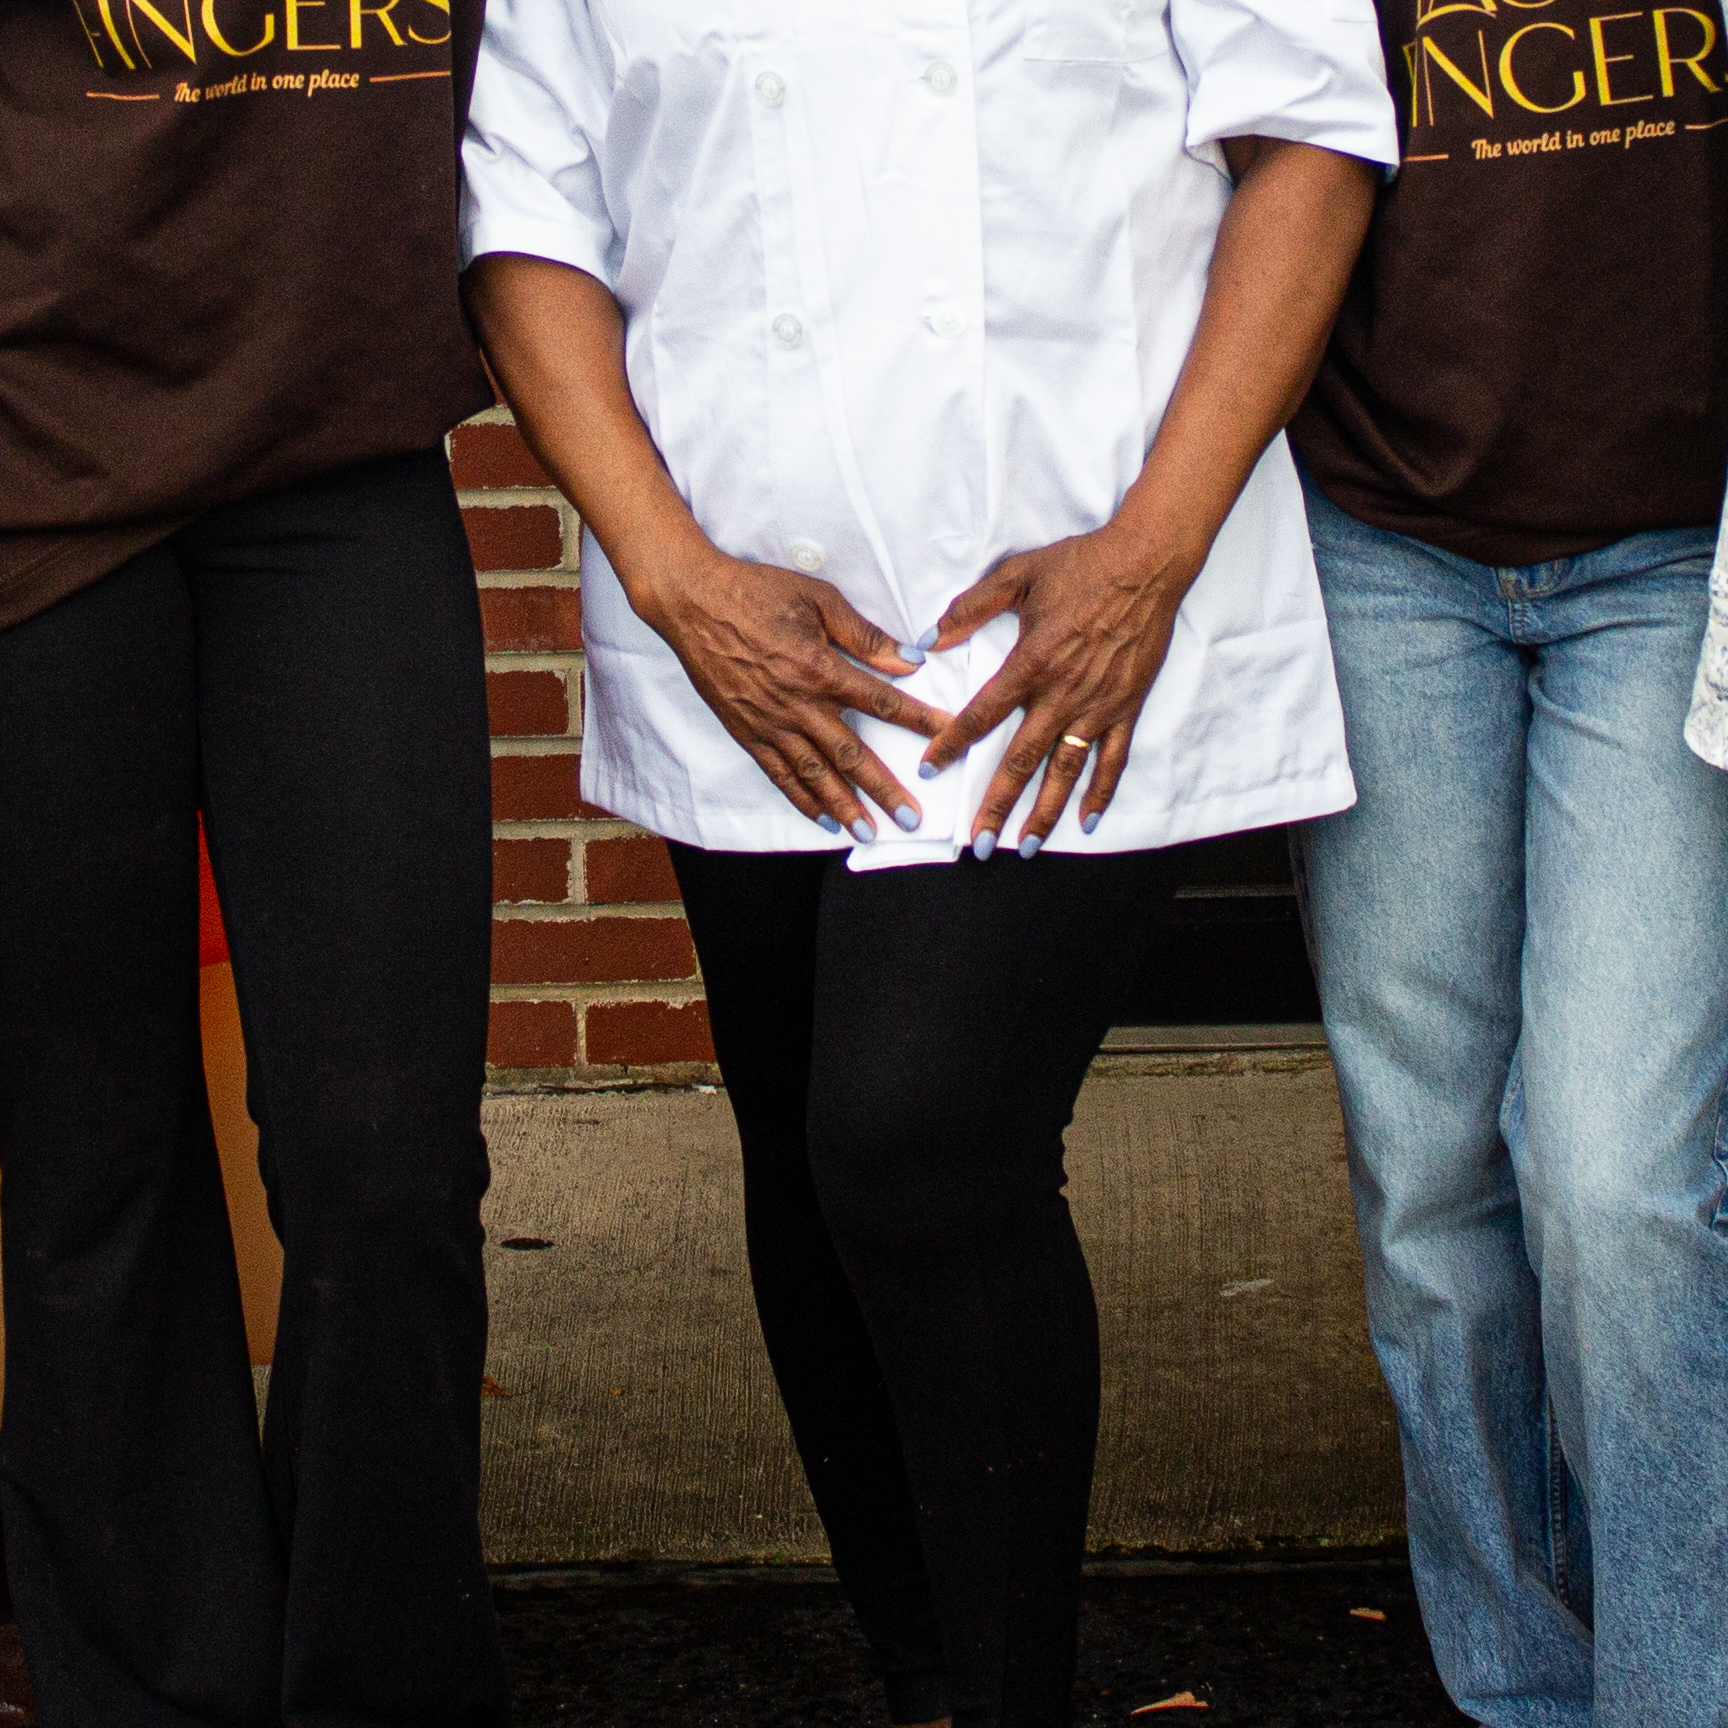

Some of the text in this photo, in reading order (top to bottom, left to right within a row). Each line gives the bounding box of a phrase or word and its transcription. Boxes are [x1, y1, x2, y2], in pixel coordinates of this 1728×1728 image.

[174, 68, 360, 103] The world in one place
[1472, 120, 1676, 160] The world in one place
